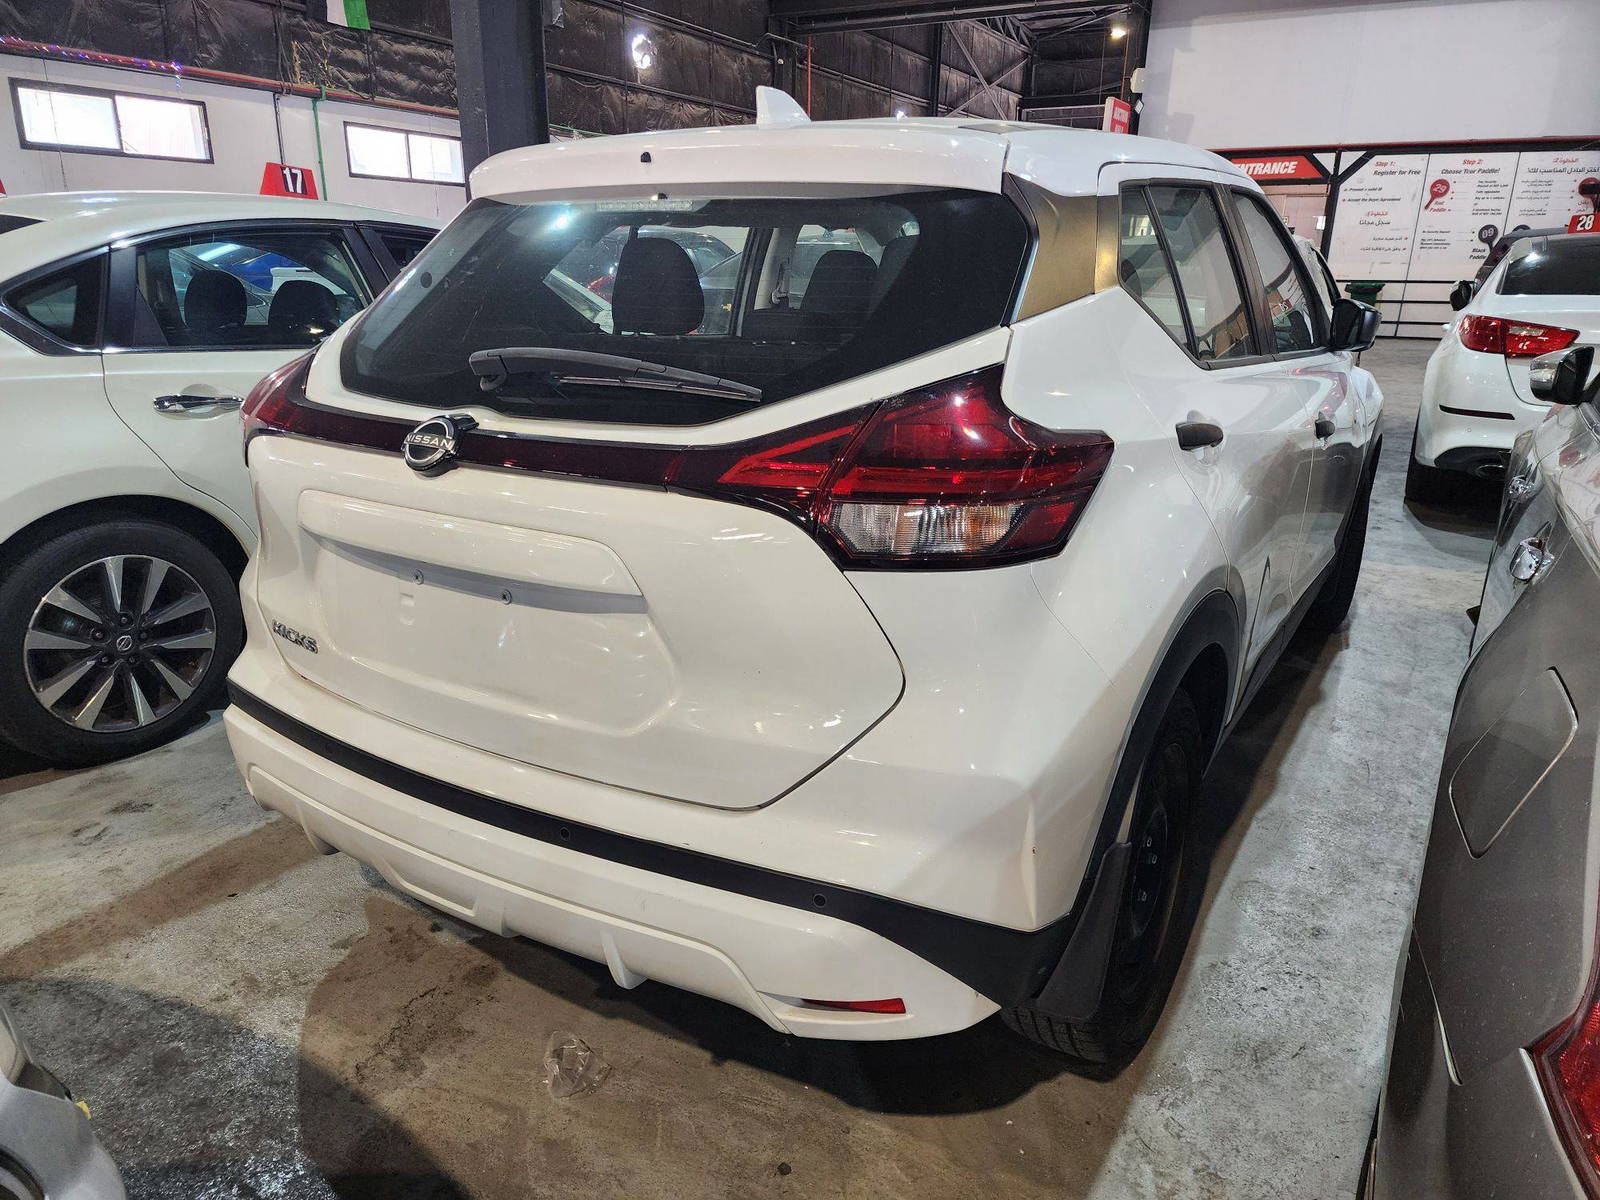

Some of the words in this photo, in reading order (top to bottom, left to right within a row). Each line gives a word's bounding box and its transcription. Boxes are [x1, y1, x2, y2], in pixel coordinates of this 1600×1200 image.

[1373, 169, 1397, 177] Register
[1477, 167, 1501, 175] Paddle!
[283, 167, 303, 194] 17
[1576, 214, 1595, 231] 28
[1482, 227, 1495, 239] 09
[404, 433, 456, 451] NISSAN
[271, 619, 319, 654] KICKS
